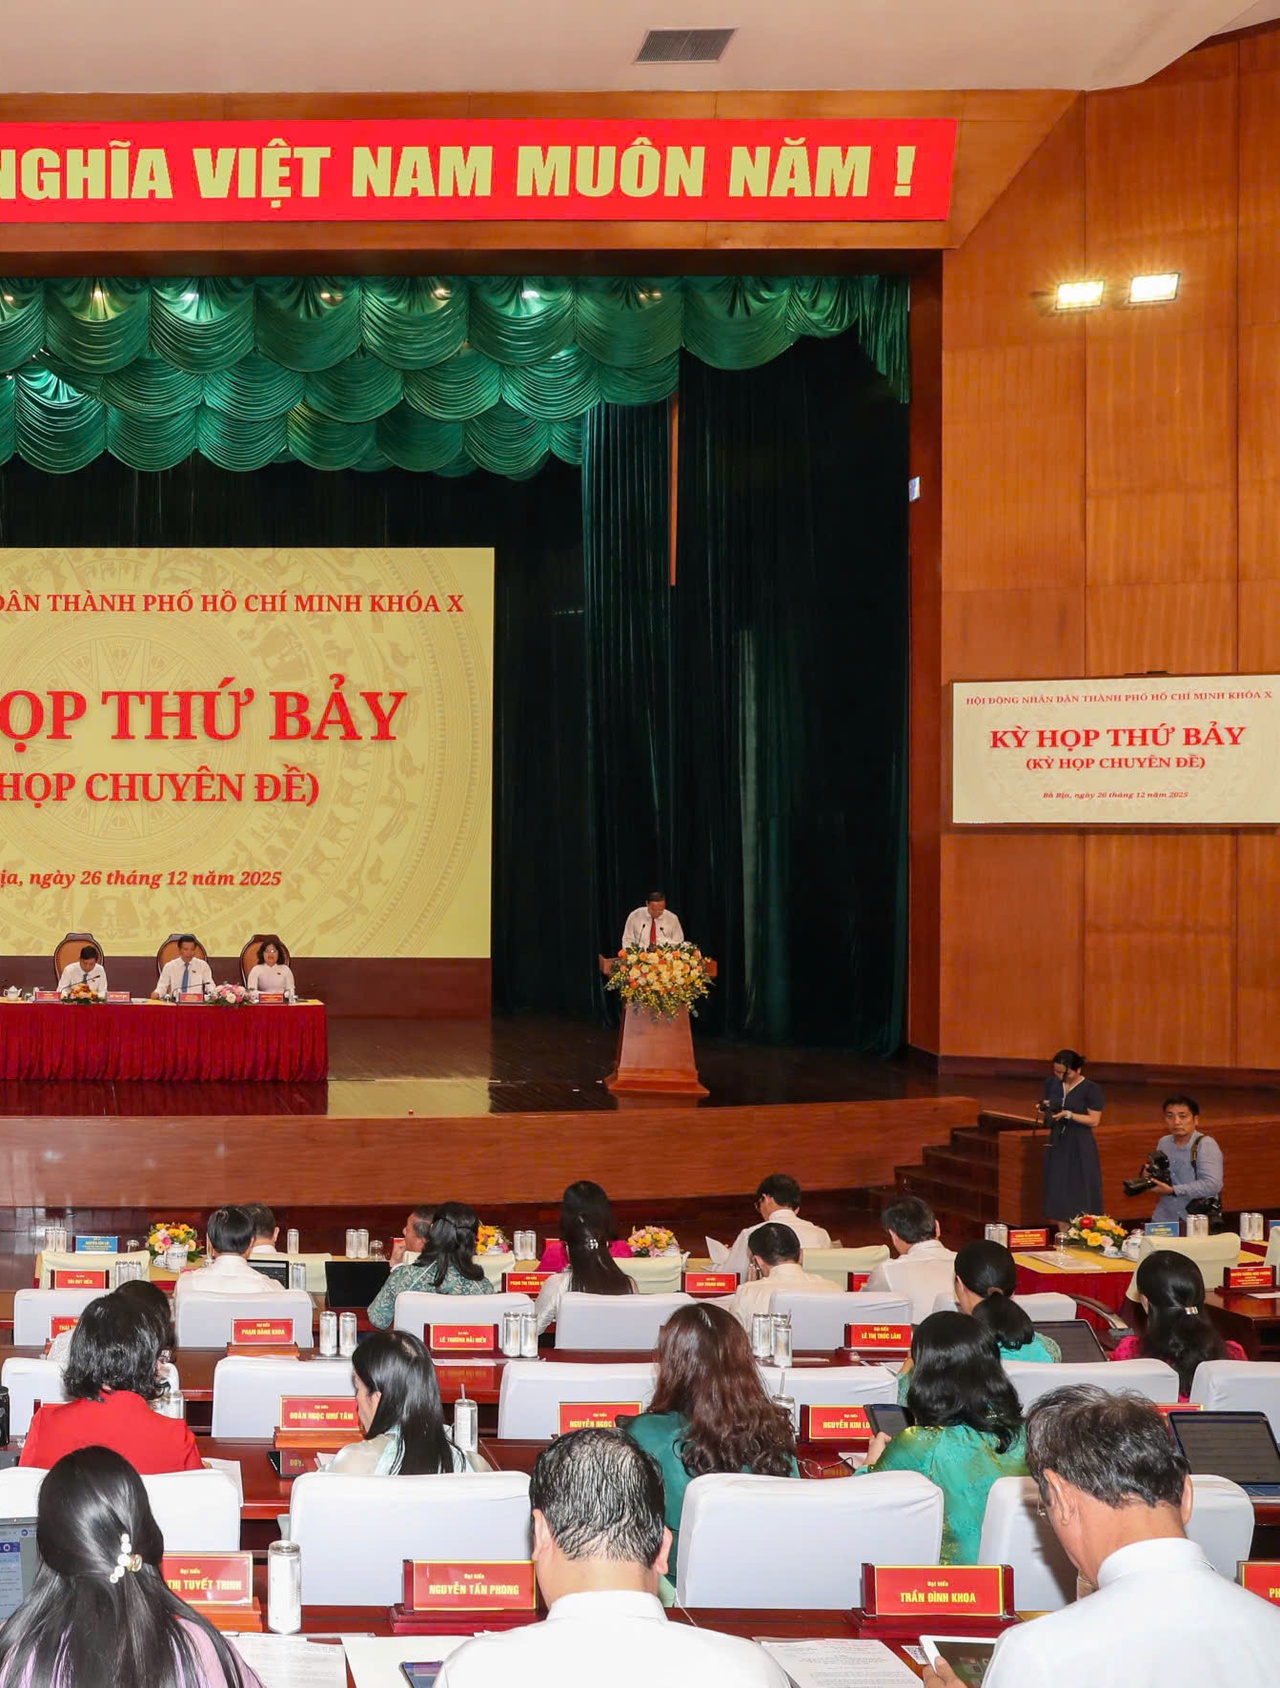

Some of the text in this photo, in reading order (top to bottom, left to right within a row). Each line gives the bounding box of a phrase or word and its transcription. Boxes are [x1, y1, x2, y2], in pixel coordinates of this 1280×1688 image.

[193, 138, 331, 208] VIỆT
[352, 146, 492, 197] NAM
[517, 137, 705, 197] MUÔN
[729, 137, 871, 196] NĂM
[894, 146, 916, 196] !
[48, 589, 135, 612] THÀNH
[143, 588, 194, 612] PHỐ
[201, 588, 237, 612] HỒ
[244, 589, 288, 612] CHÍ
[294, 594, 362, 613] MINH
[370, 590, 440, 612] KHÓA
[447, 595, 464, 612] X
[101, 676, 253, 741] THỨ
[268, 673, 408, 741] BẢY
[966, 690, 1273, 705] HỘI ĐỒNG NHÂN DÂN THÀNH PHỐ HỒ CHÍ MINH KHÓA X
[989, 721, 1246, 751] KỲ HỌP THỨ BẢY
[1026, 755, 1206, 772] (KỲ HỌP CHUYÊN ĐỀ)
[85, 765, 245, 803] CHUYÊN
[255, 764, 320, 807] ĐỀ)
[29, 871, 76, 890] ngày
[81, 870, 102, 885] 26
[106, 870, 162, 890] tháng
[169, 871, 188, 886] 12
[193, 871, 235, 886] năm
[240, 871, 282, 886] 2025
[167, 1580, 181, 1592] THỊ
[183, 1577, 213, 1591] TUYẾT
[429, 1581, 519, 1595] NGUYỄN TẤN PHONG
[900, 1589, 976, 1602] TRẦN ĐÌNH KHOA
